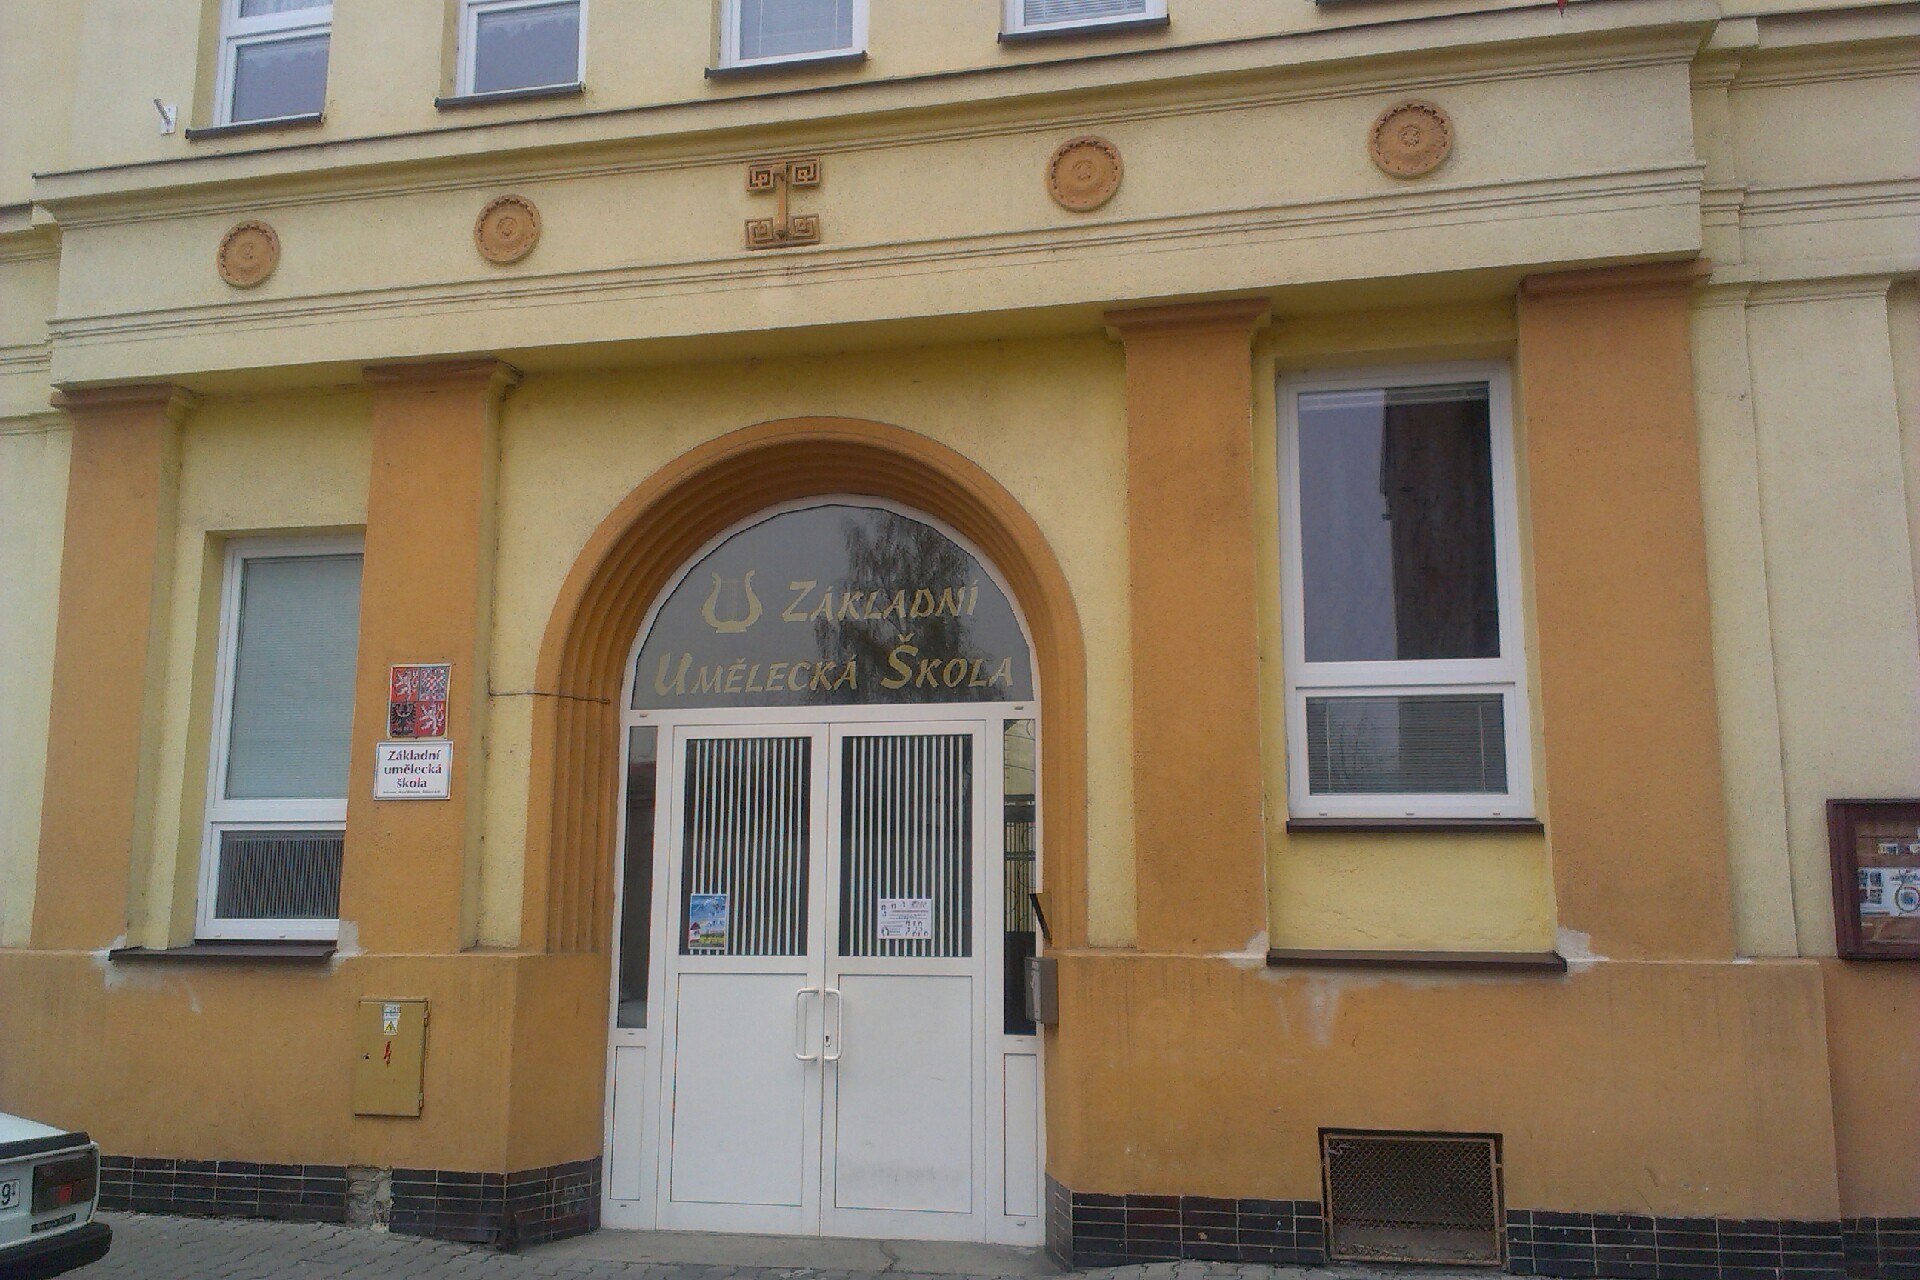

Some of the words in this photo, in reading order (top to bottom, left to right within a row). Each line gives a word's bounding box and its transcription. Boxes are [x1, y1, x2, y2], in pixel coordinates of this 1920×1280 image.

[387, 750, 441, 761] Základní
[384, 763, 442, 775] umělecká
[397, 776, 427, 788] škola
